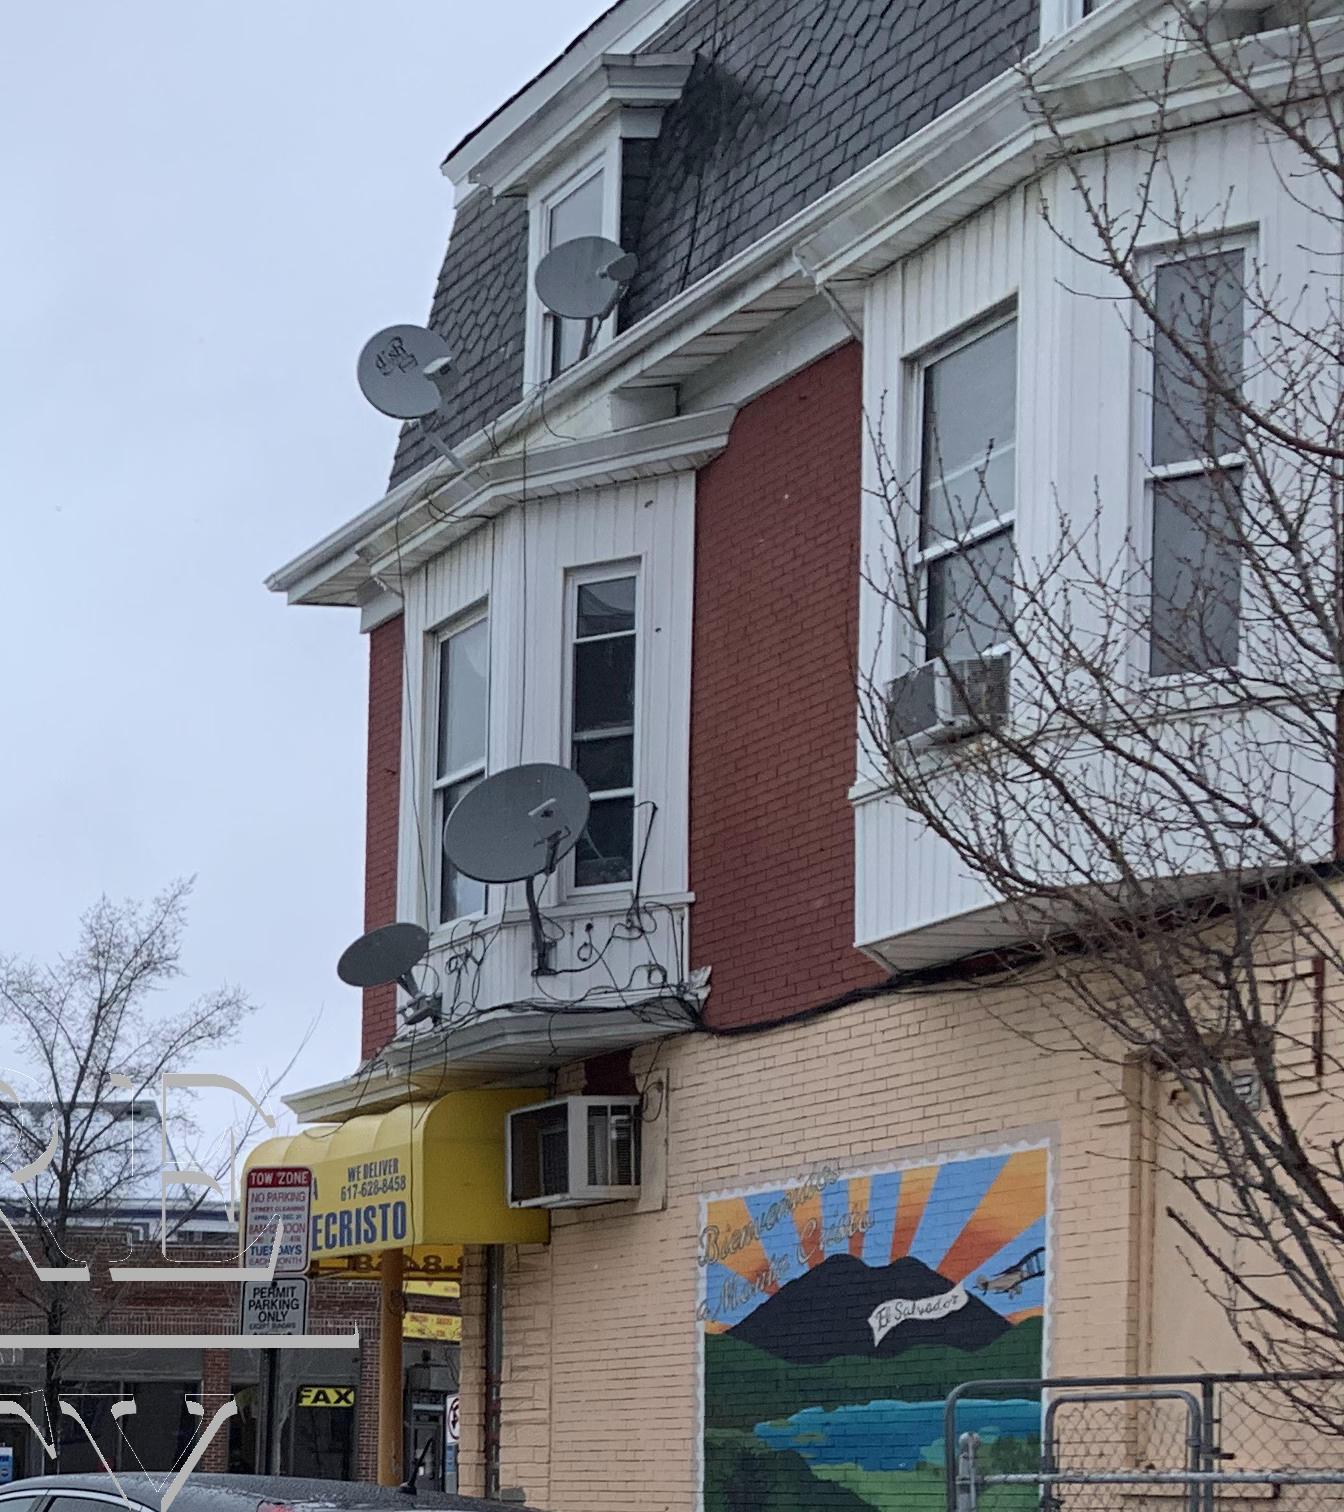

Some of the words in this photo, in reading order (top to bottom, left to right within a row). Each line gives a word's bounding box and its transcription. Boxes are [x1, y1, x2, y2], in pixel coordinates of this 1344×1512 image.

[347, 1166, 361, 1183] WE
[363, 1158, 399, 1180] DELIVER
[250, 1172, 274, 1185] TOW
[278, 1171, 309, 1185] ZONE
[340, 1175, 406, 1202] 617-628-8458
[251, 1193, 265, 1203] NO
[267, 1192, 306, 1202] PARKING
[253, 1287, 297, 1299] PERMIT
[248, 1298, 300, 1310] PARKING
[894, 1294, 959, 1321] Salvador
[258, 1311, 289, 1323] ONLY
[299, 1387, 352, 1404] FAX
